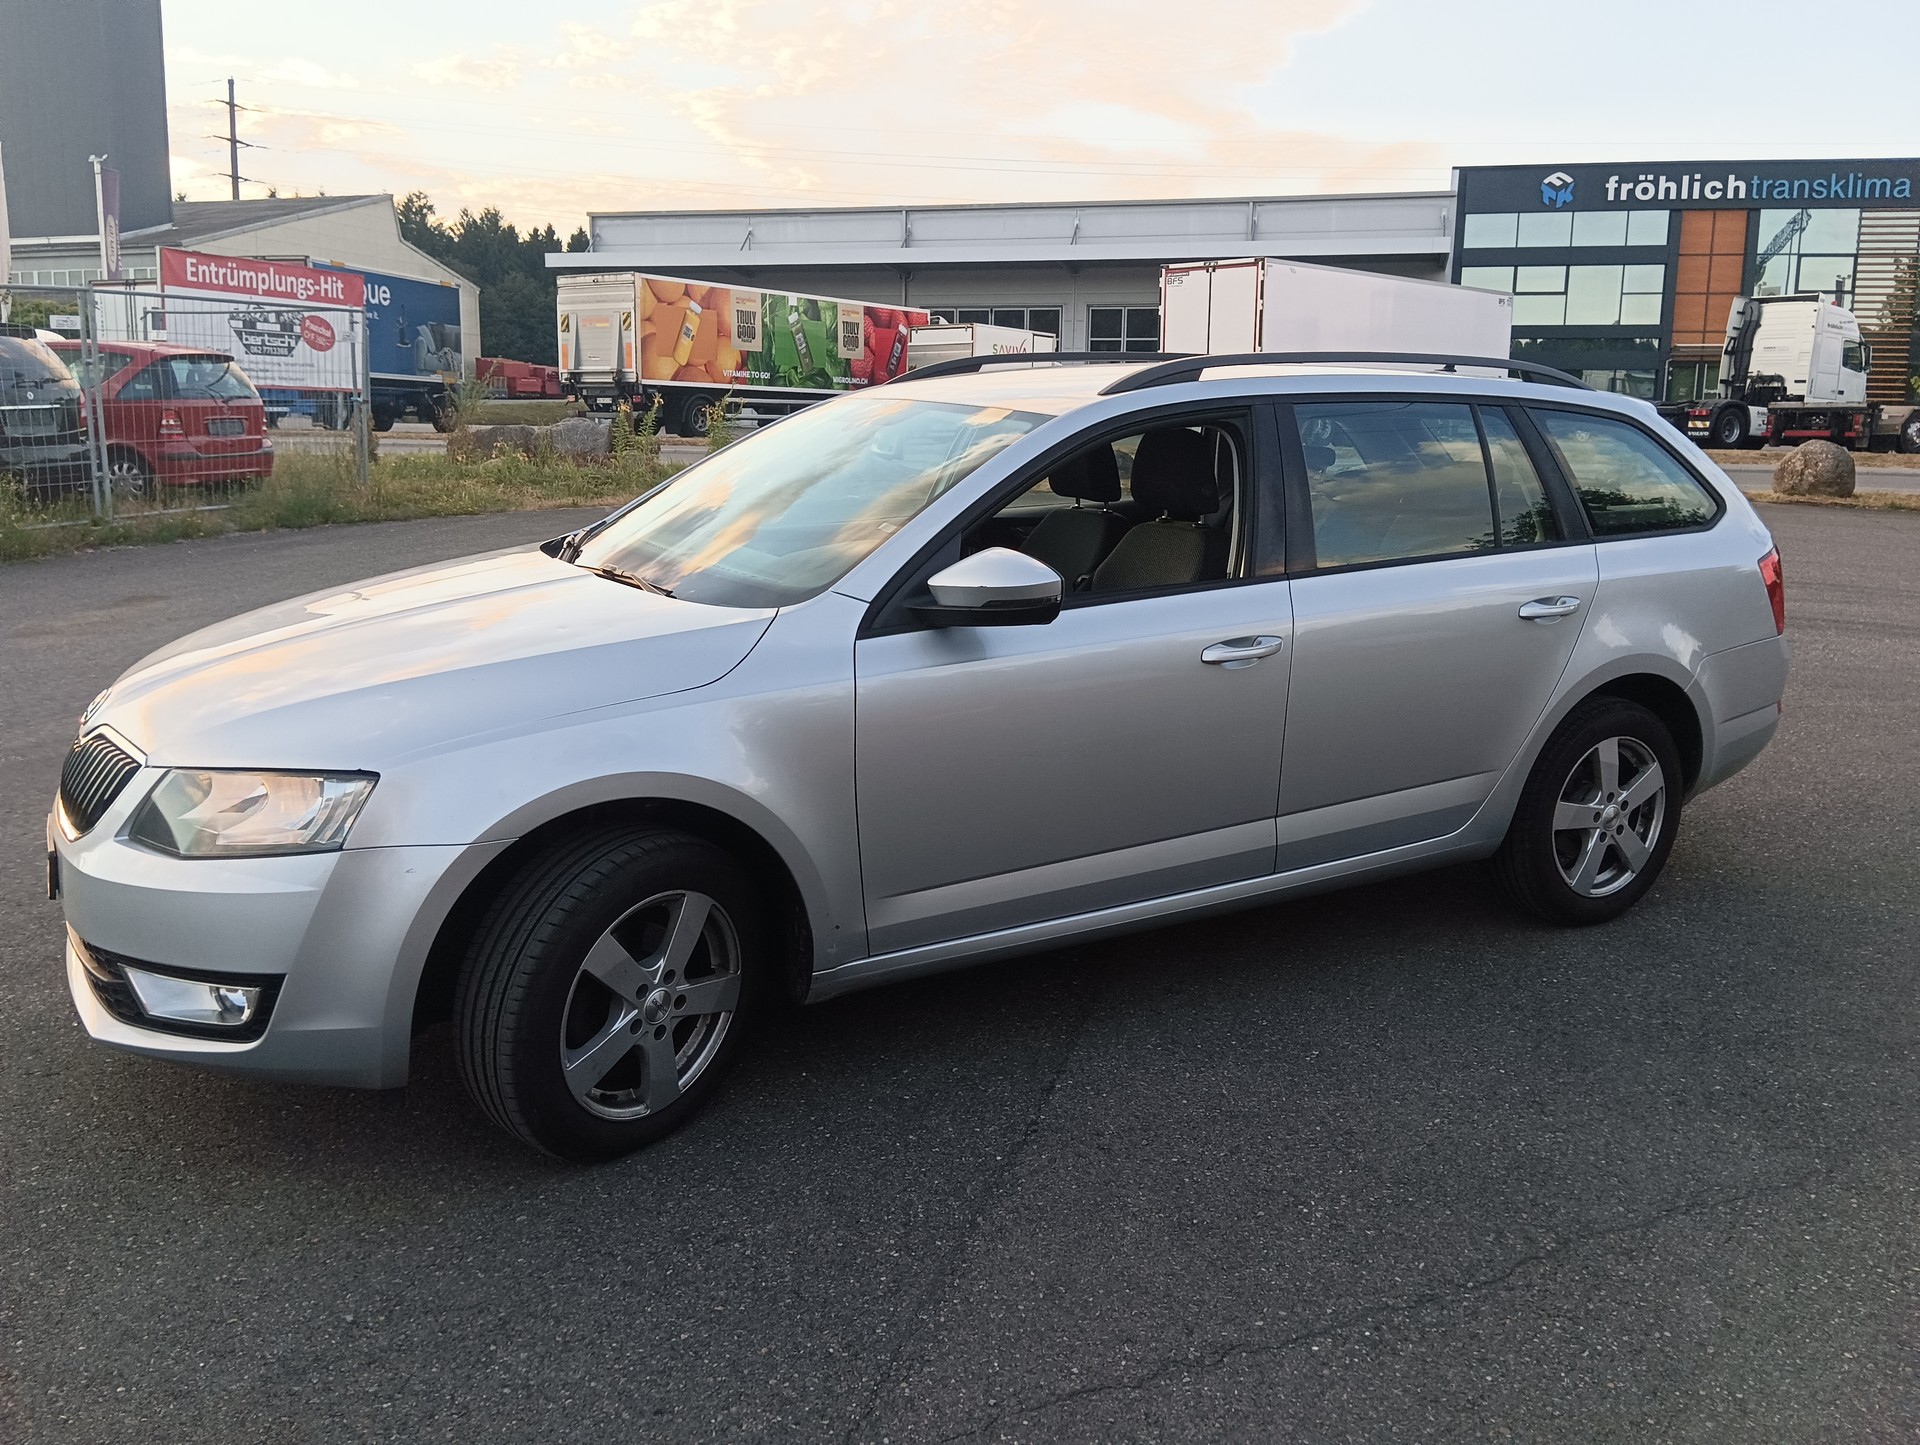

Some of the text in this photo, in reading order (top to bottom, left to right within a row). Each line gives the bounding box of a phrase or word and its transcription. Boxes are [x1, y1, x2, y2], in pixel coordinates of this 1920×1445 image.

[186, 257, 344, 300] Entrümplungs-Hit
[1167, 277, 1183, 285] BFS
[363, 283, 391, 306] ue
[736, 309, 757, 326] TRULY
[737, 325, 756, 340] GOOD
[842, 321, 860, 336] TRULY
[242, 331, 296, 347] bertschi
[843, 335, 859, 349] GOOD
[992, 338, 1027, 354] SAVIVA
[722, 369, 751, 378] VITAMINE
[832, 376, 868, 384] MIGROLINO.CH
